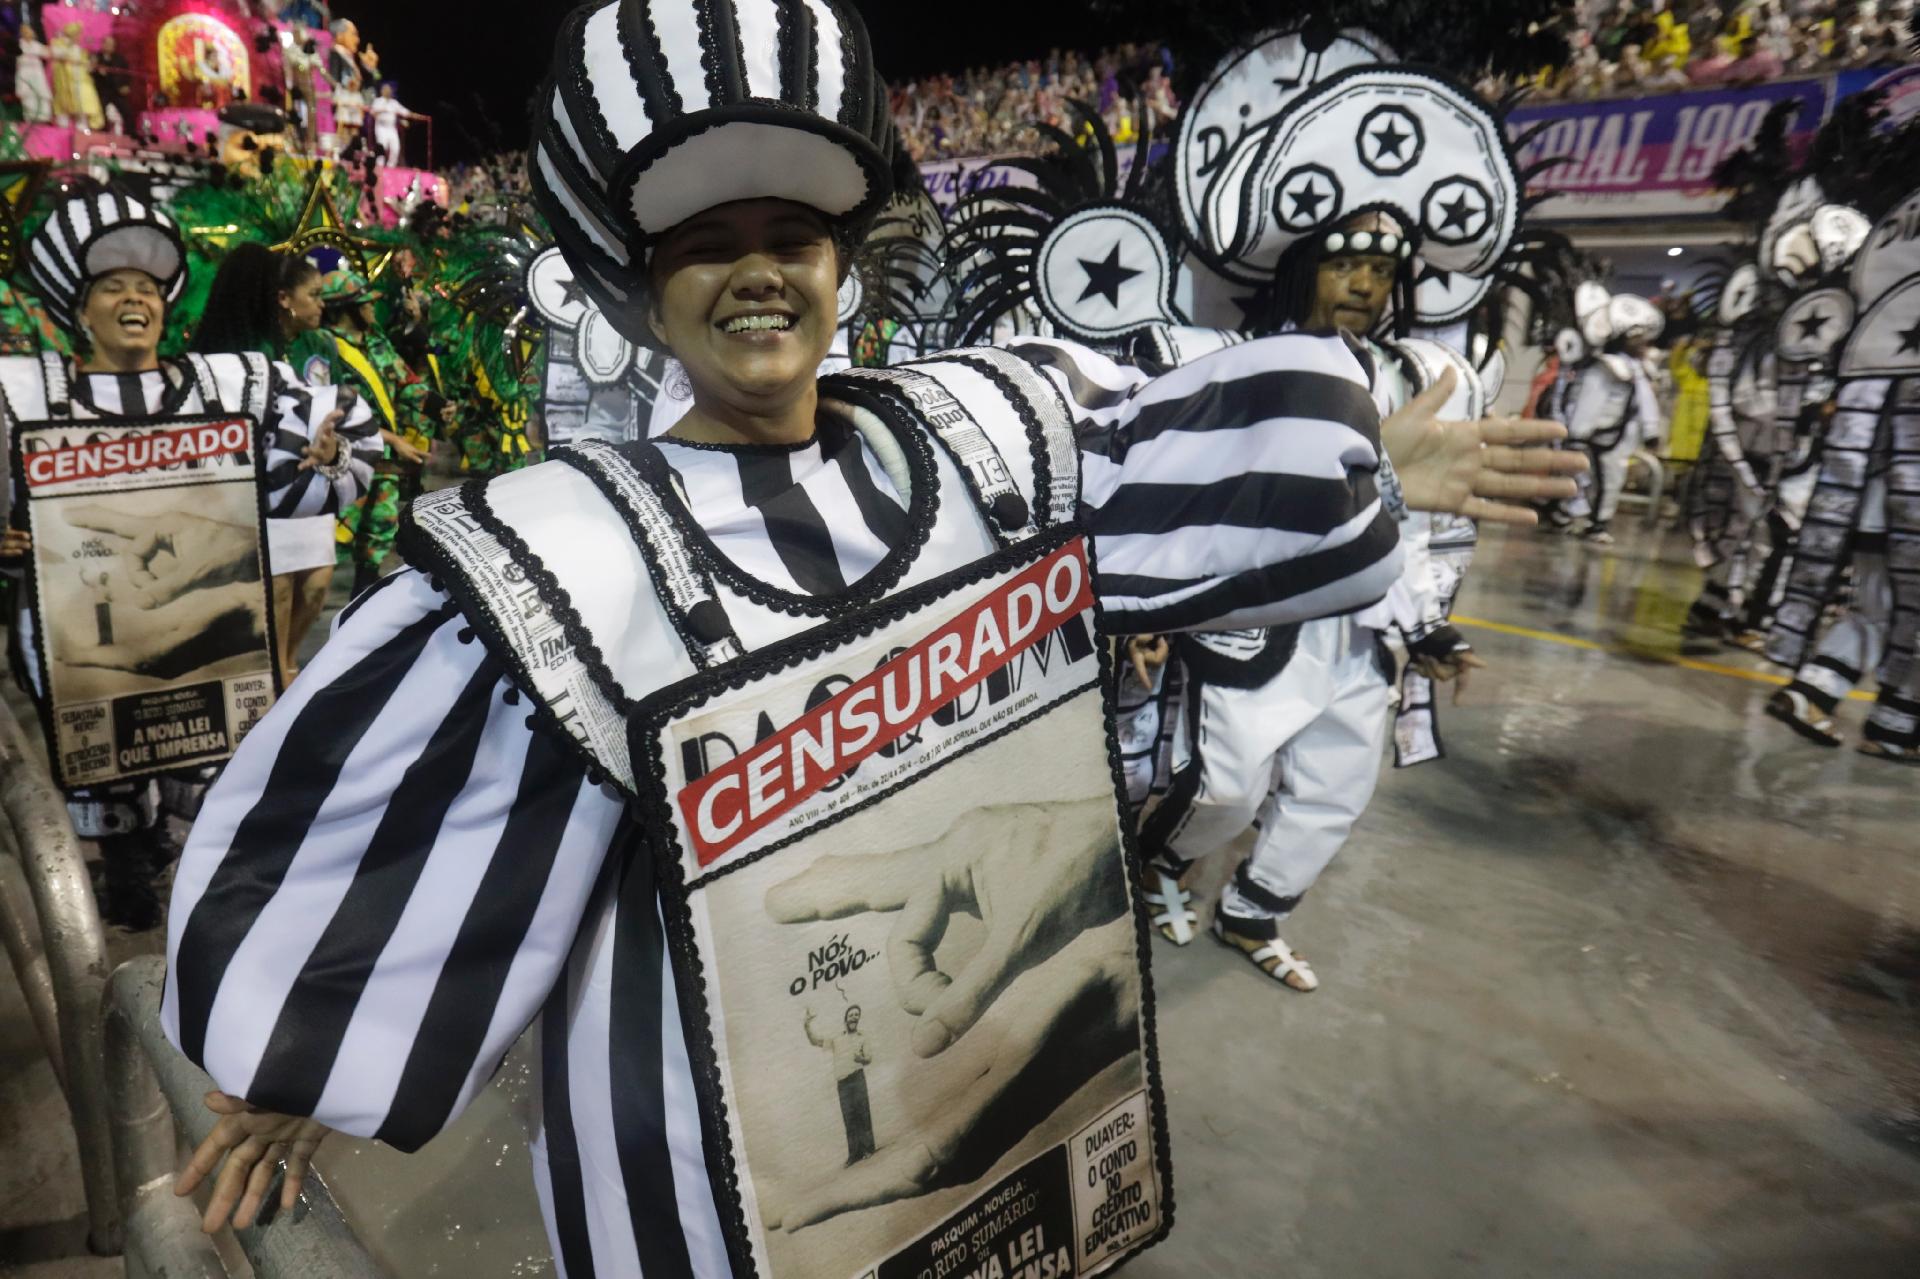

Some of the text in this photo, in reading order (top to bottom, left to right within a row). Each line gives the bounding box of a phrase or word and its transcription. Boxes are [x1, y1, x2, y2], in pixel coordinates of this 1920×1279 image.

[29, 424, 245, 483] CENSURADO
[656, 524, 668, 540] Her
[697, 553, 1082, 844] CENSURADO
[120, 745, 151, 768] QUE
[155, 731, 226, 759] IMPRENSA
[134, 716, 210, 745] A NOVA LEI
[789, 814, 805, 828] ANO
[805, 808, 819, 821] VIII
[857, 784, 871, 794] Rio,
[872, 780, 879, 789] de
[942, 737, 952, 749] UM
[953, 727, 978, 743] JORNAL
[980, 719, 991, 731] QUE
[993, 710, 1006, 723] NÃO
[1006, 706, 1014, 717] SE
[789, 949, 880, 996] O POVO...
[808, 932, 853, 973] NÓS,
[1085, 1112, 1136, 1158] DUAYER:
[1088, 1139, 1137, 1188] O CONTO
[1106, 1171, 1122, 1197] DO
[931, 1178, 1028, 1257] PASQUIM NOVELA:
[1085, 1200, 1150, 1256] EDUCATIVO
[934, 1242, 967, 1279] RITO
[1008, 1223, 1045, 1270] LEI
